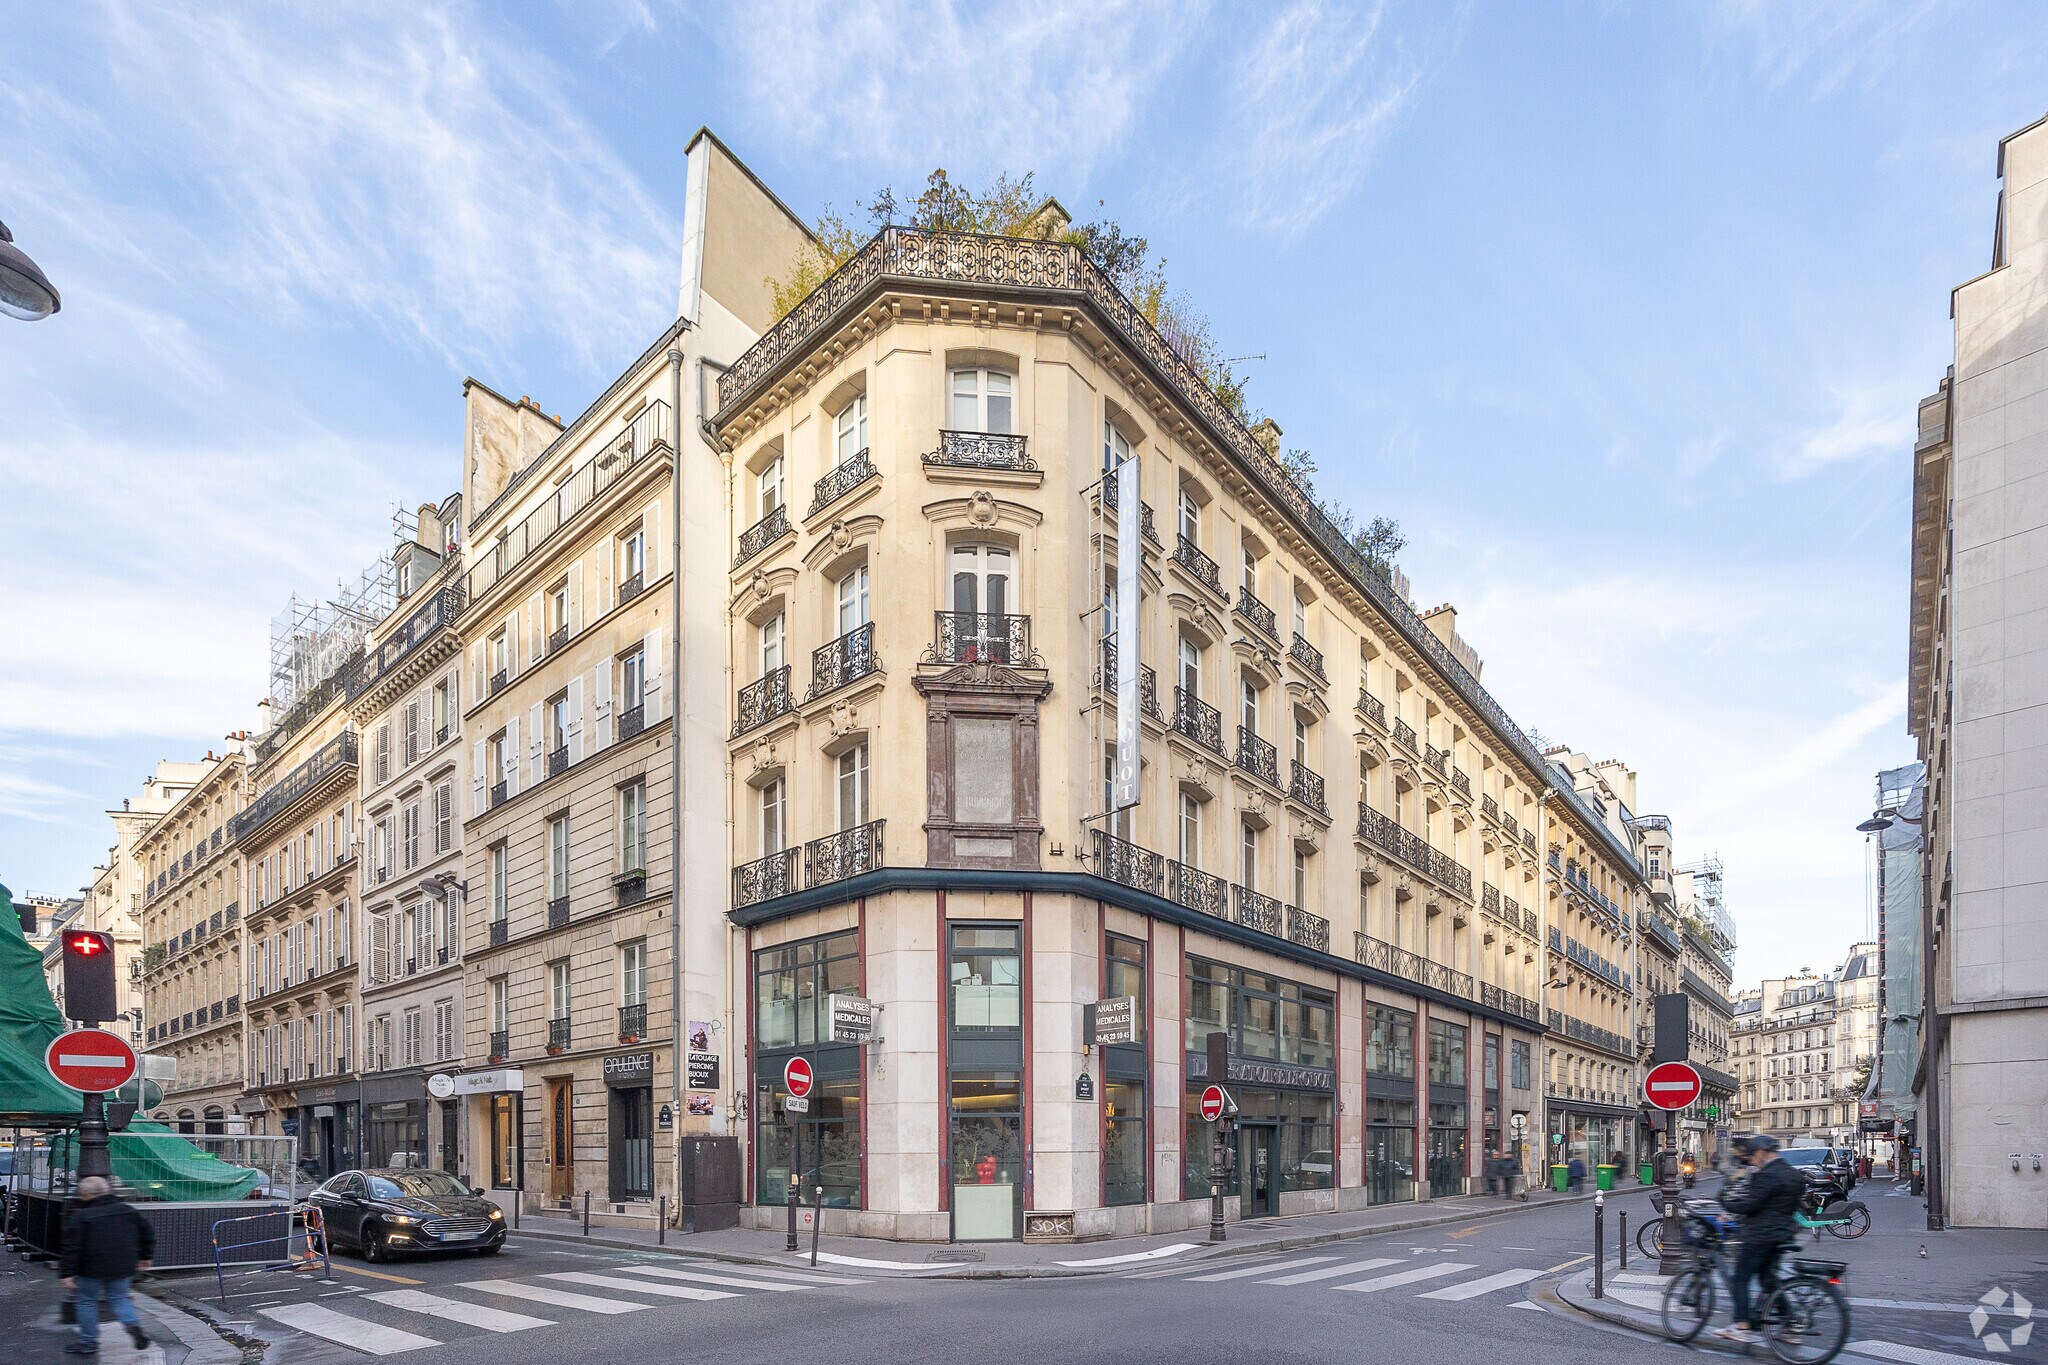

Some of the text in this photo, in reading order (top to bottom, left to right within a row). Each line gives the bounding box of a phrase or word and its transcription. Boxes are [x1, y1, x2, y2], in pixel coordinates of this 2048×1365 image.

[836, 1000, 869, 1011] ANALYSES
[1097, 1001, 1129, 1013] ANALYSES
[835, 1013, 870, 1024] MEDICALES
[1096, 1014, 1130, 1025] MEDICALES
[1123, 1031, 1130, 1039] 45
[689, 1054, 718, 1062] TATOUAGE
[604, 1054, 650, 1074] OPULENCE
[689, 1062, 714, 1070] PIERCING
[788, 1100, 798, 1108] SAUF
